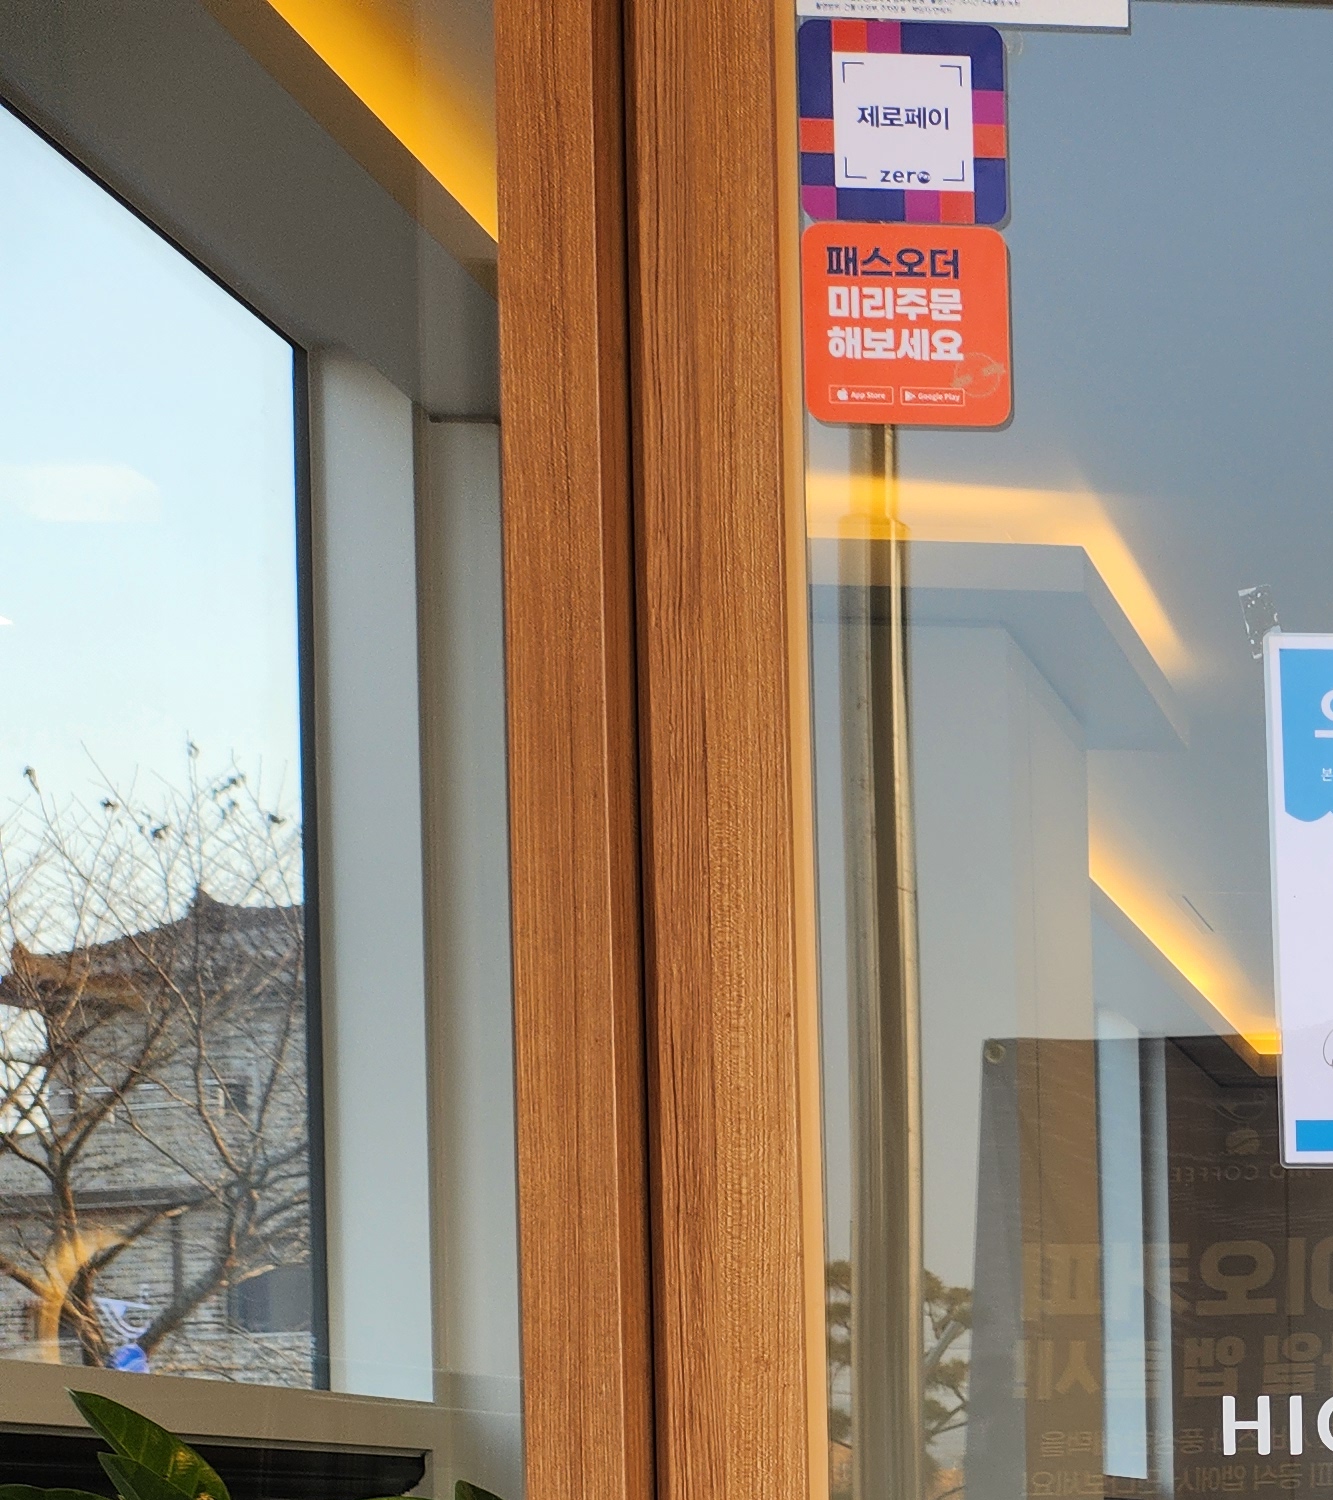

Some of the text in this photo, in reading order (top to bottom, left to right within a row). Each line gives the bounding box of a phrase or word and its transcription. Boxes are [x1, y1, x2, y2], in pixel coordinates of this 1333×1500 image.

[857, 105, 950, 130] 제로페이
[880, 168, 931, 184] zero
[826, 246, 959, 279] 패스오더
[827, 286, 963, 321] 미리주문
[827, 327, 964, 361] 해보세요
[851, 391, 886, 400] App Store
[917, 392, 960, 402] Google Play
[1322, 768, 1333, 781] 본
